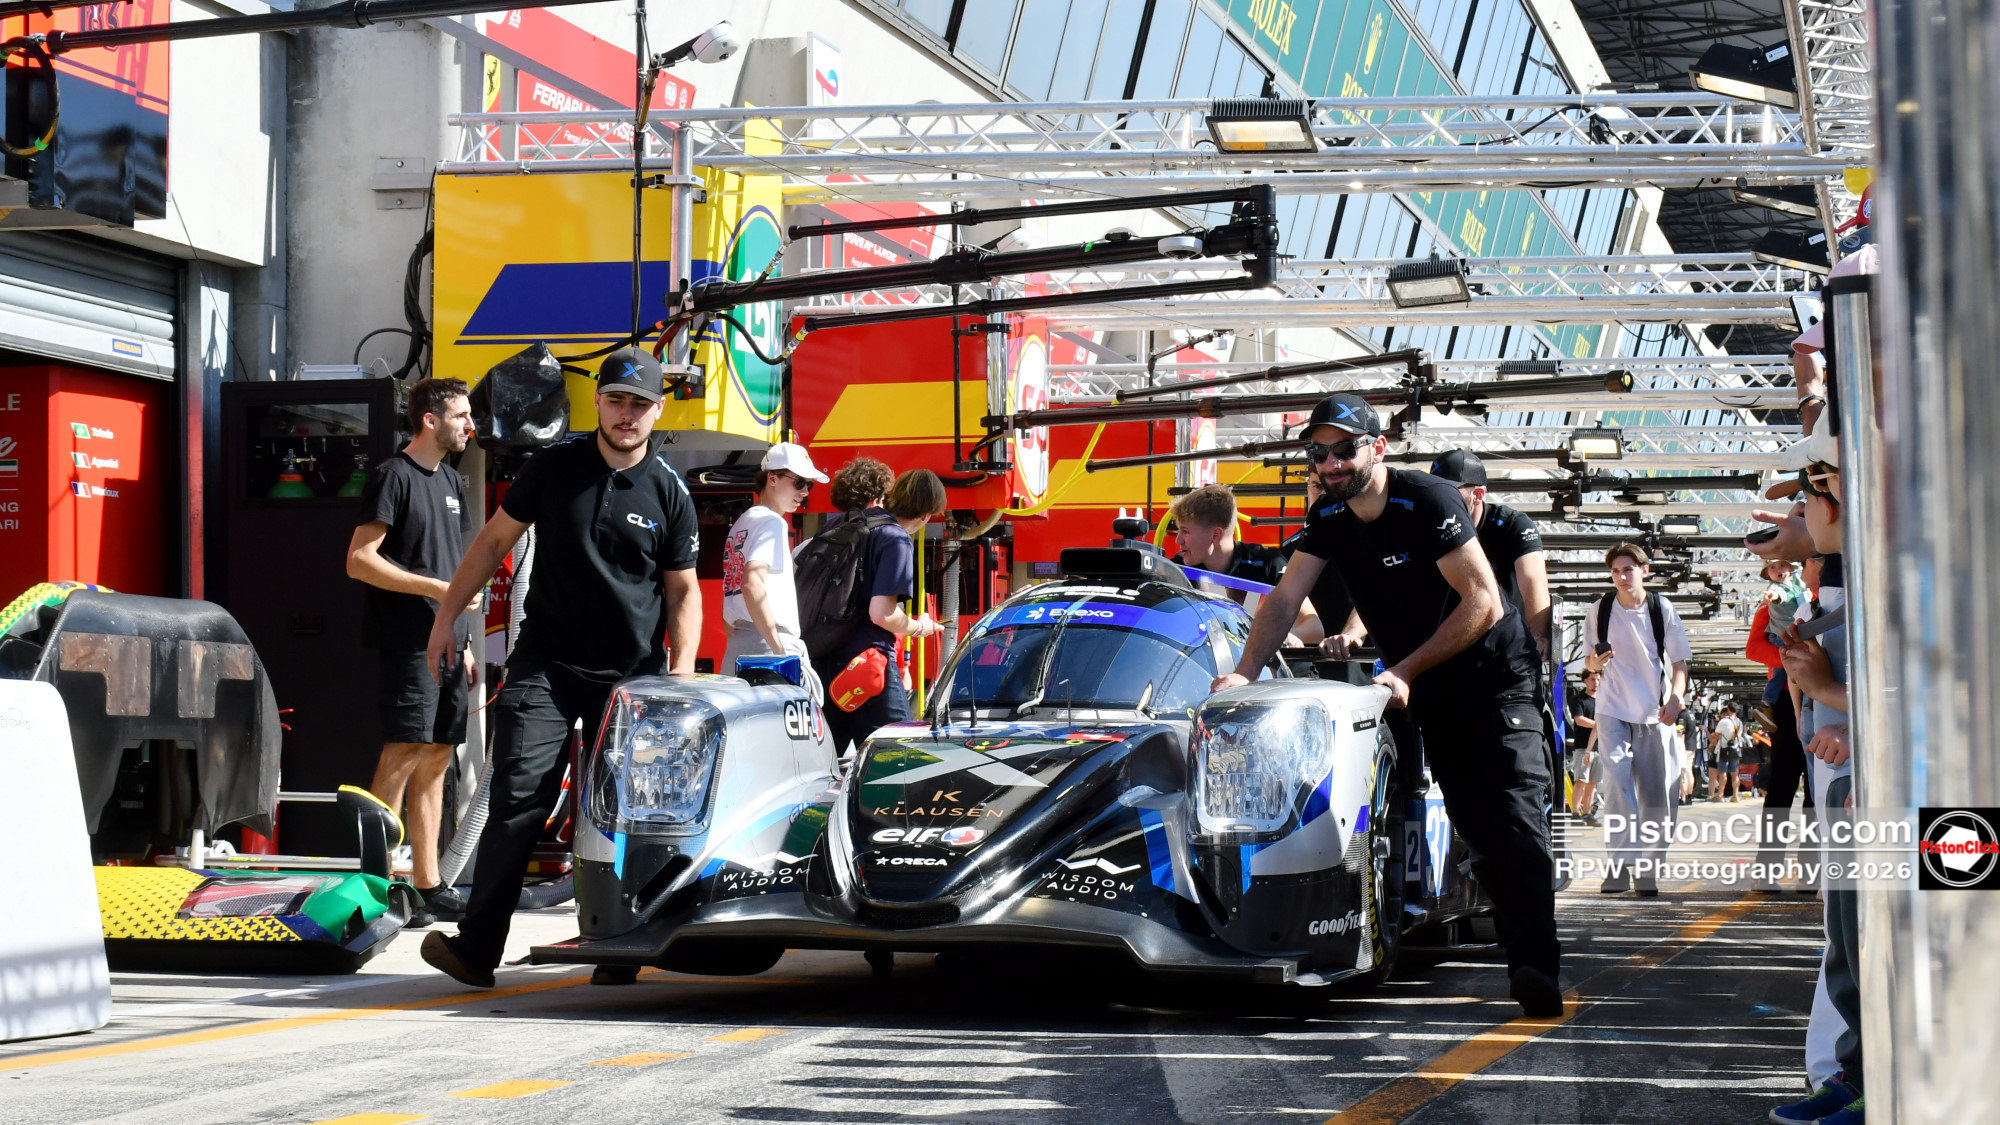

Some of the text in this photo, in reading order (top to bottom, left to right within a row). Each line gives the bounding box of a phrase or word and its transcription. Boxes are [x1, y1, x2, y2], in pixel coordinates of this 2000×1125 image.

[1460, 209, 1487, 257] ROLEX
[626, 512, 659, 533] CLX
[1382, 551, 1412, 567] CLX
[784, 700, 812, 737] elf
[873, 806, 1004, 818] KLAUSEN
[872, 827, 945, 843] elf
[890, 857, 948, 867] ORECA
[723, 867, 810, 883] WISDOM
[1041, 872, 1134, 893] WISDOM
[728, 876, 794, 891] AUDIO
[1046, 881, 1117, 900] AUDIO
